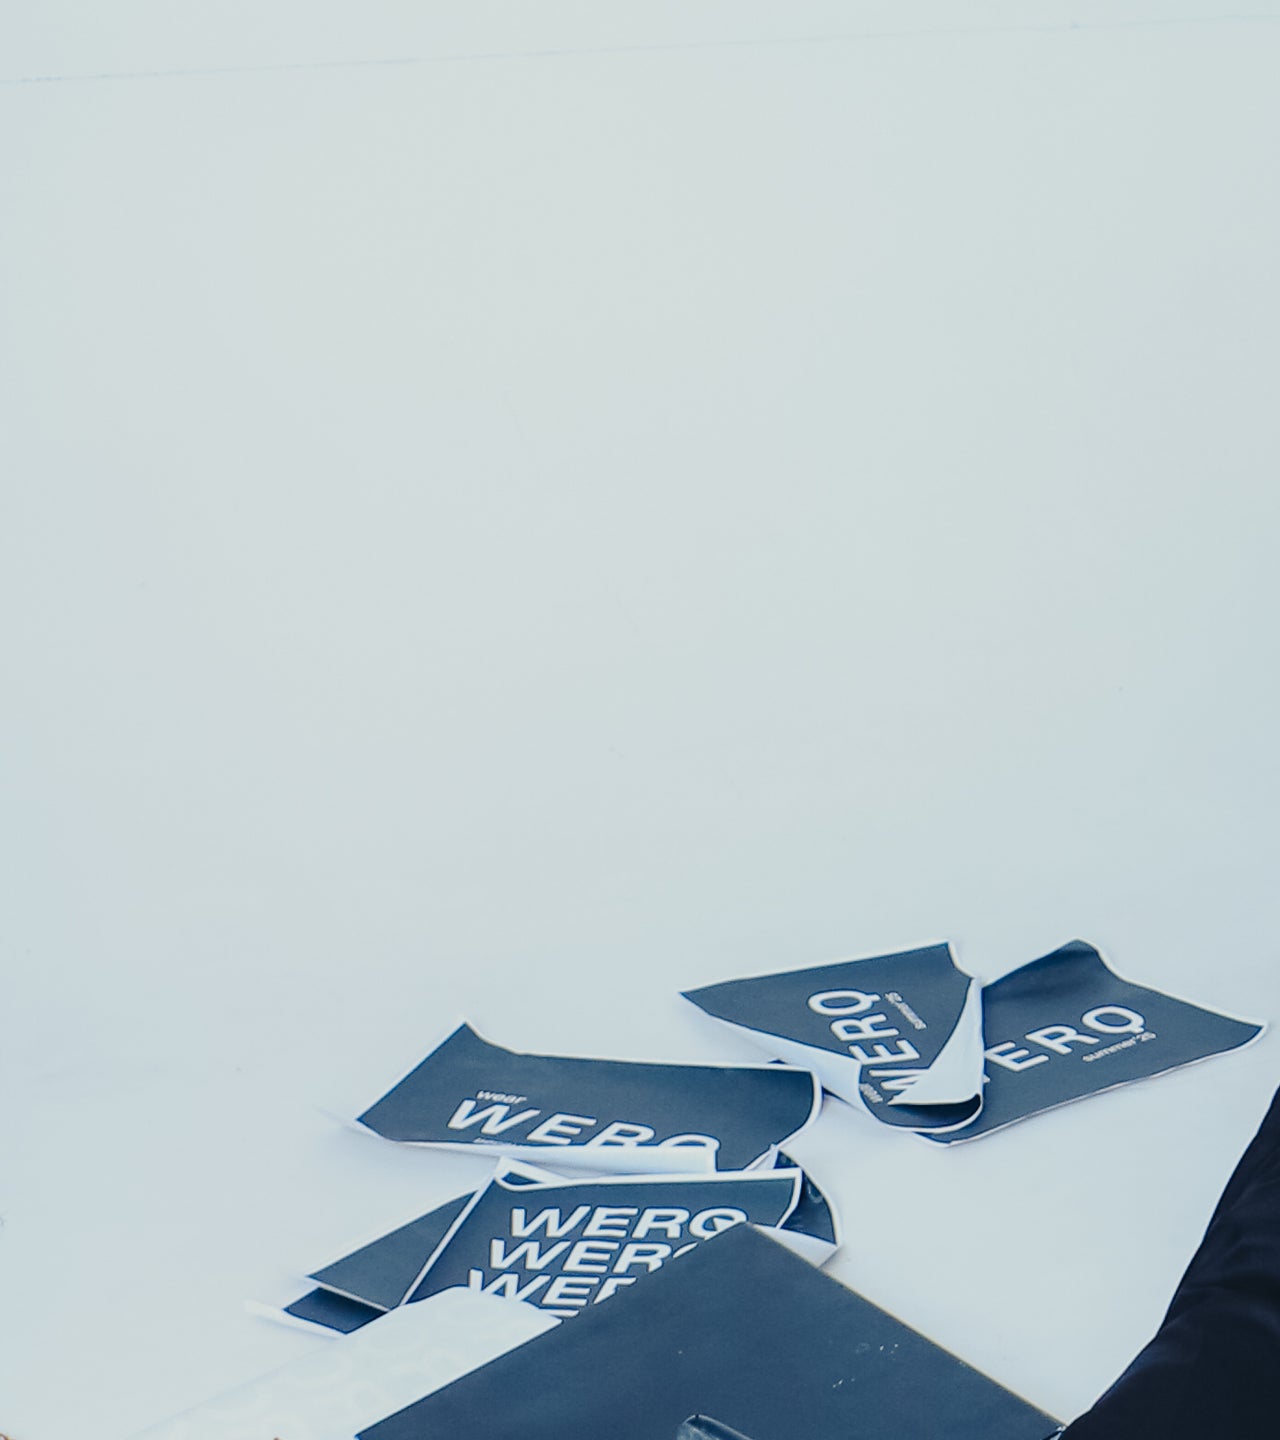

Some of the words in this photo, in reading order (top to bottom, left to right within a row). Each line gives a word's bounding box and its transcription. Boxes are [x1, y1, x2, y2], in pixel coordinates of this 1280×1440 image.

[984, 1006, 1144, 1082] ERQ
[476, 1089, 527, 1105] wear
[491, 1238, 697, 1273] WER
